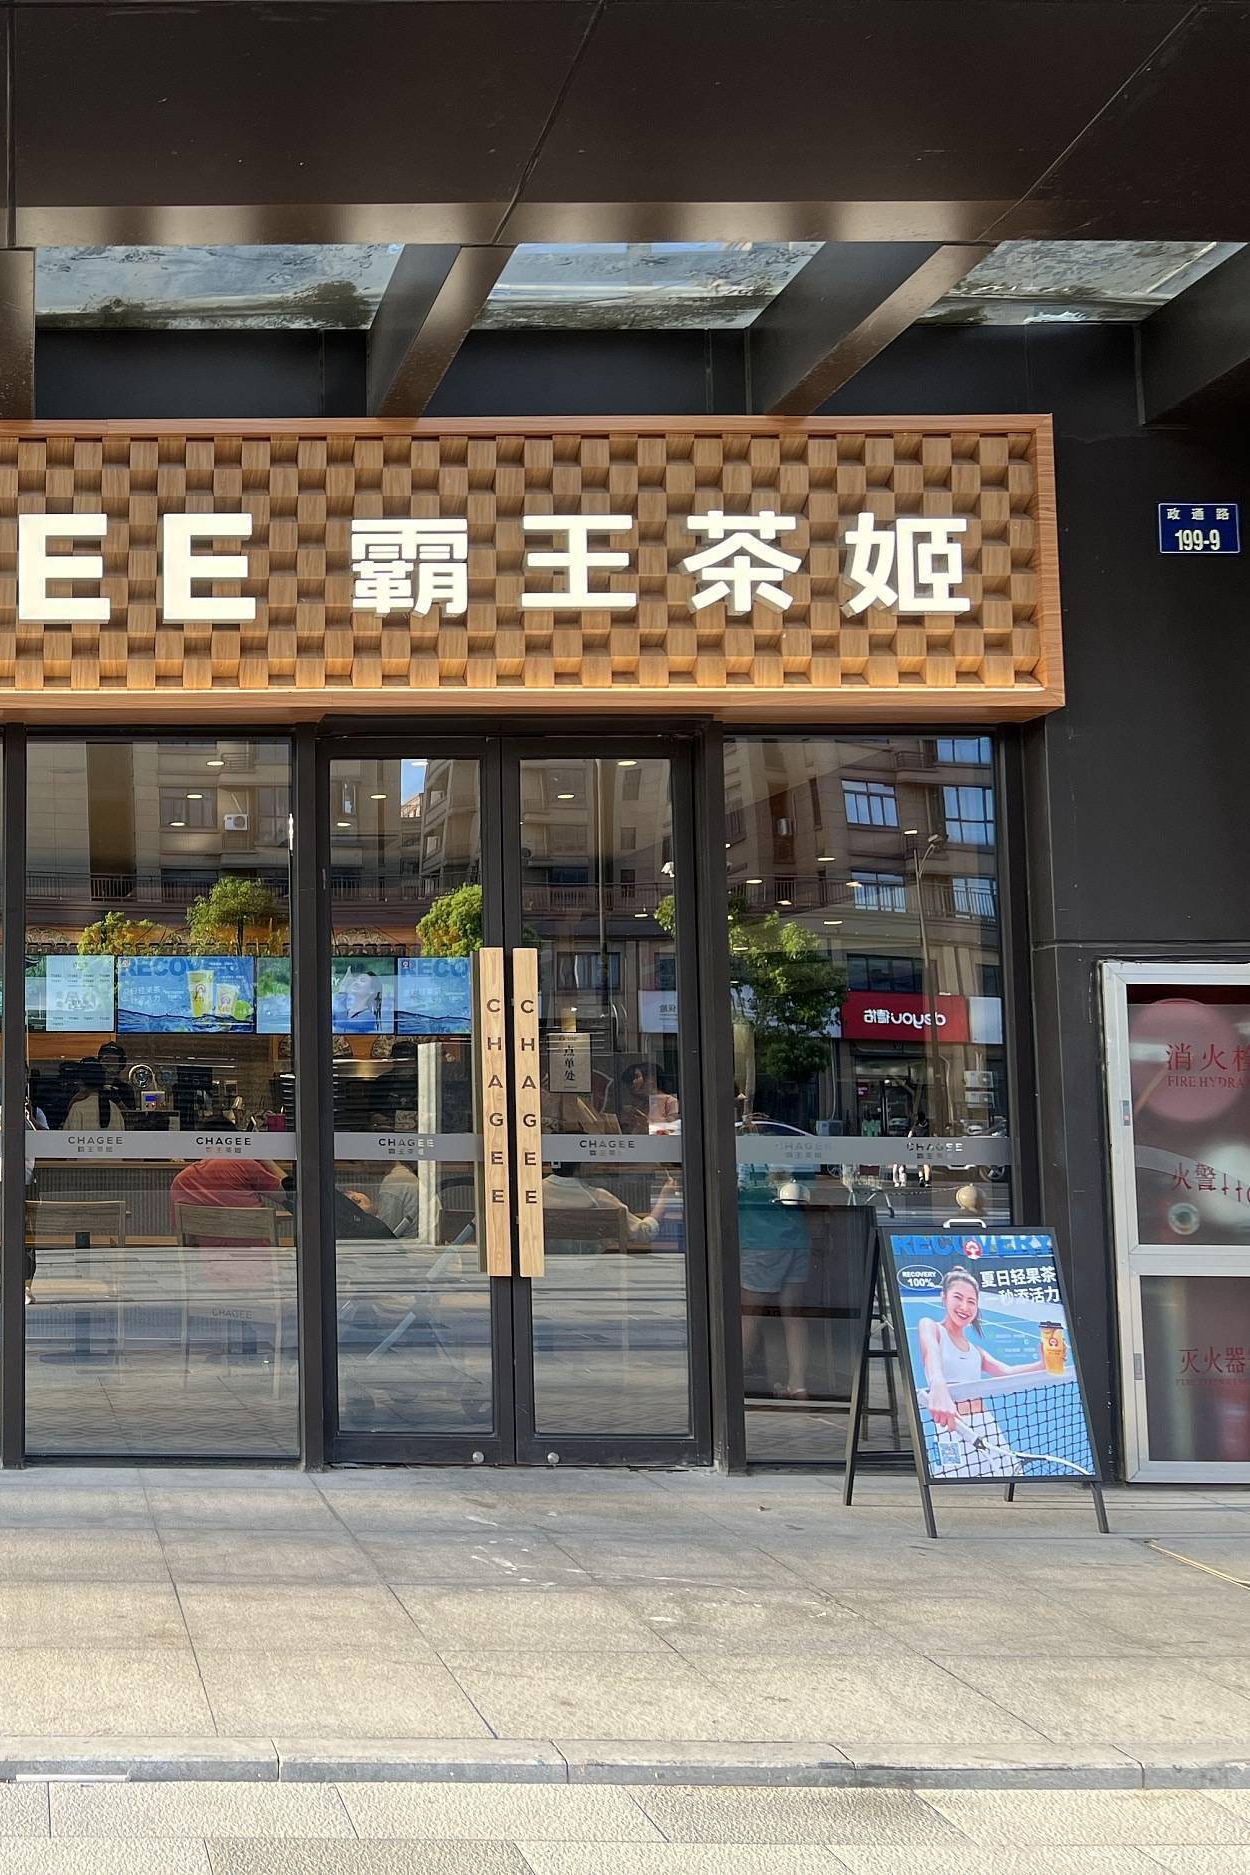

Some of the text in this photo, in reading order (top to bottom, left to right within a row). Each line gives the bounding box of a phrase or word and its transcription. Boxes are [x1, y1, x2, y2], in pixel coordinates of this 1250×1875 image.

[1166, 507, 1230, 521] 政通路
[1174, 529, 1221, 551] 199-9
[351, 510, 971, 617] 霸王茶姬
[1166, 1075, 1196, 1088] FIRE
[486, 999, 505, 1203] CHAGEE
[520, 999, 538, 1204] CHAGEE
[68, 1136, 123, 1145] CHAGEE
[196, 1136, 252, 1146] CHAGEE
[378, 1138, 435, 1147] CHAGEE
[579, 1139, 635, 1148] CHAGEE
[907, 1278, 934, 1287] 100%
[980, 1266, 1057, 1288] 夏日轻果茶
